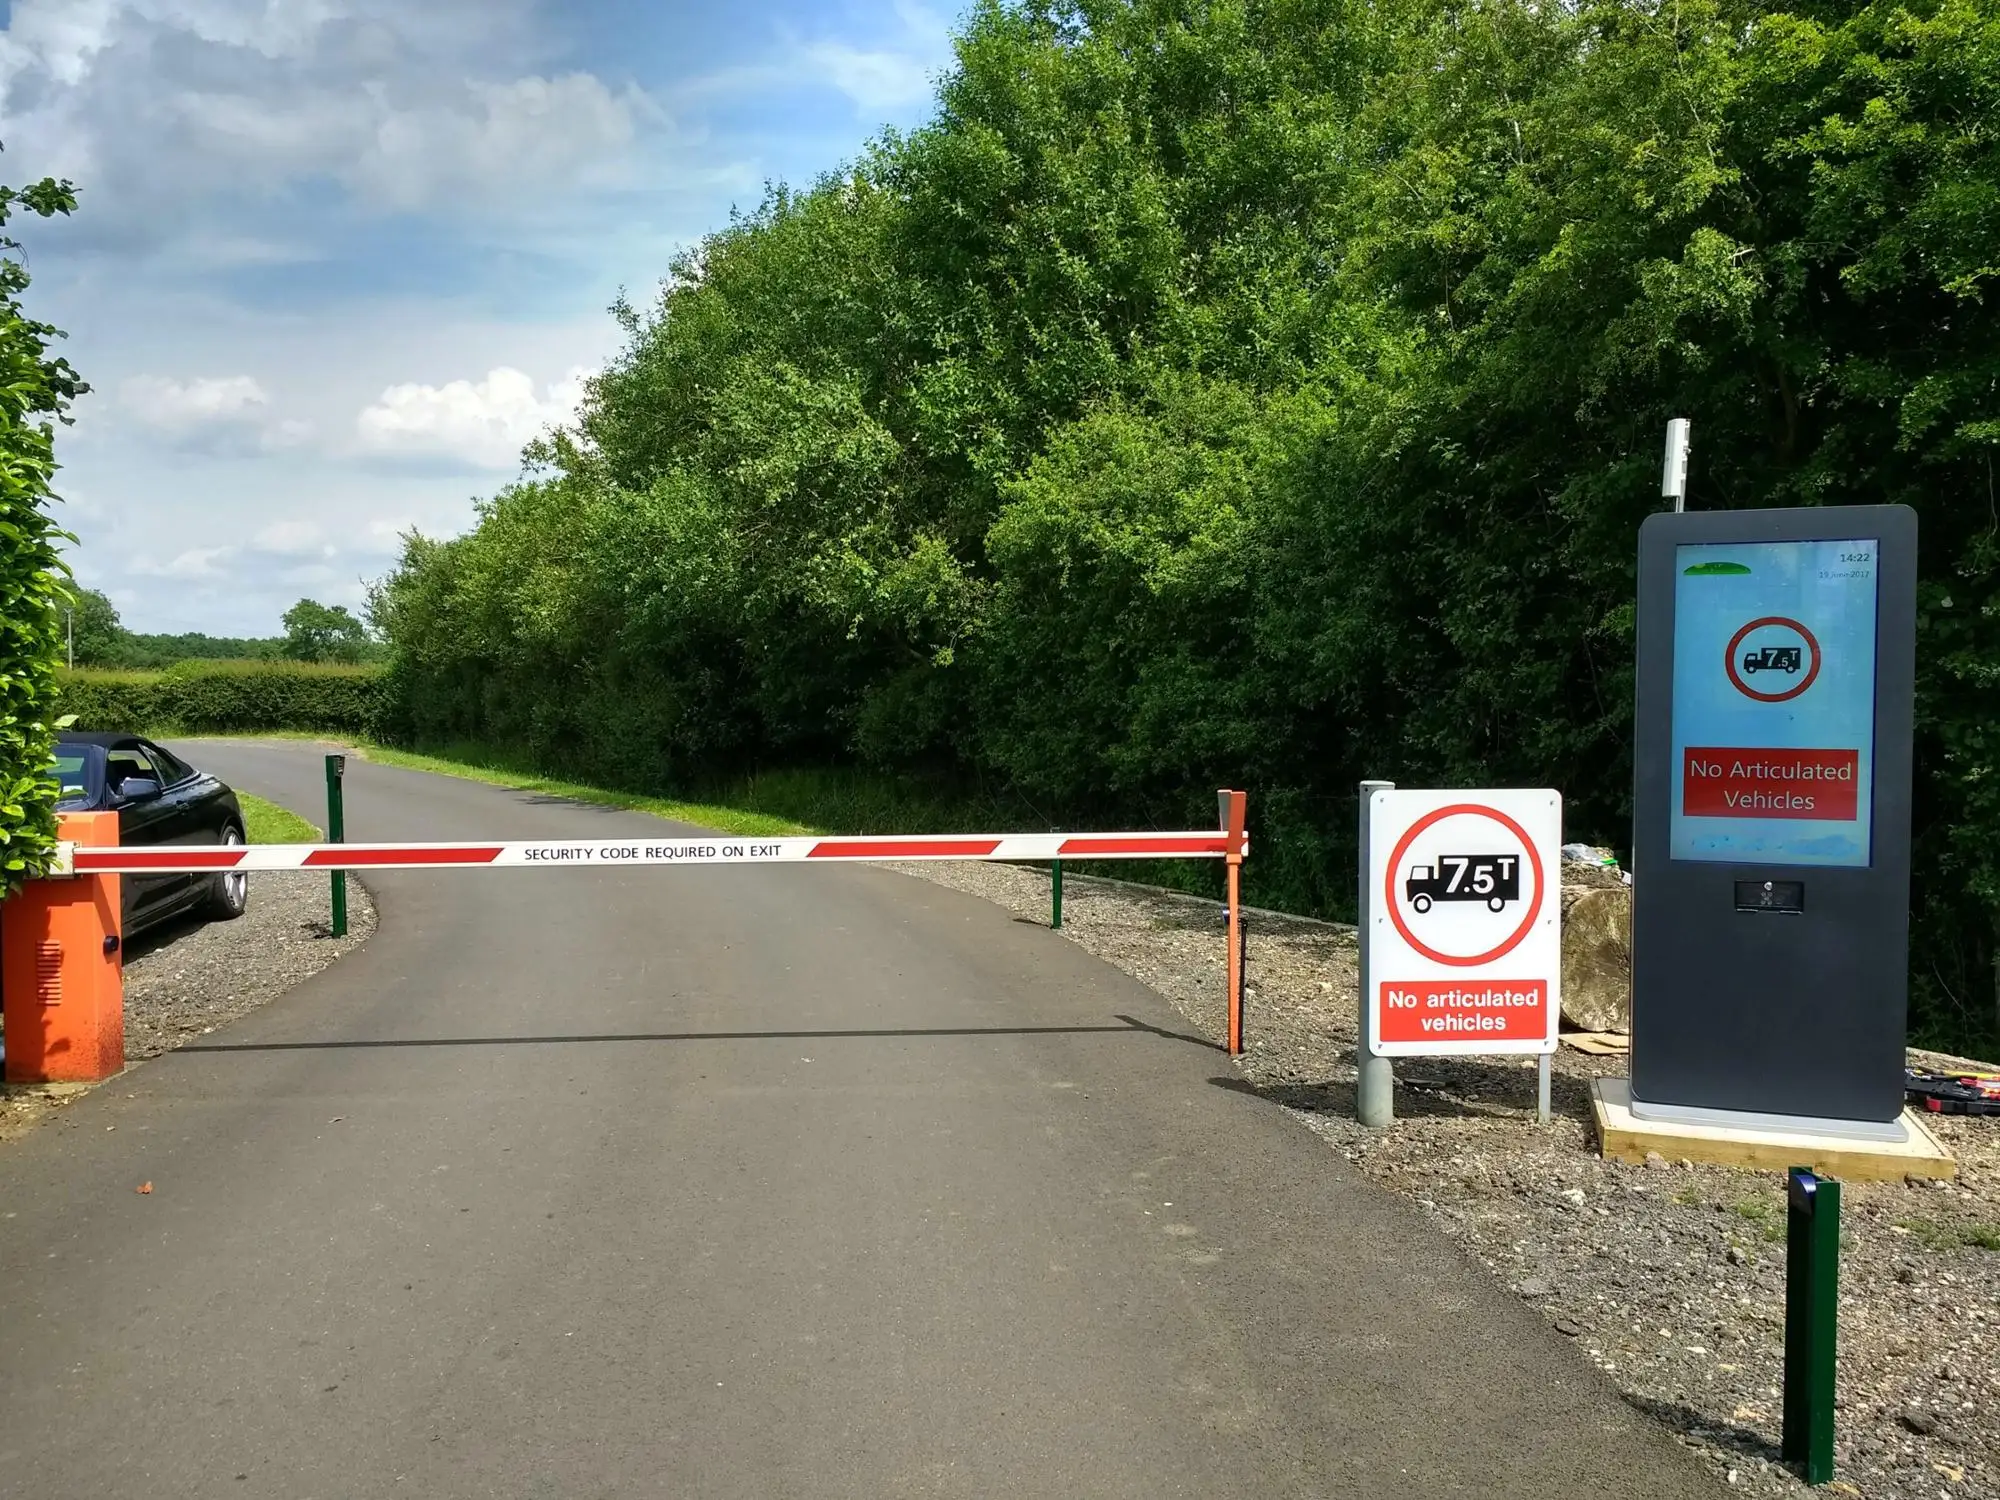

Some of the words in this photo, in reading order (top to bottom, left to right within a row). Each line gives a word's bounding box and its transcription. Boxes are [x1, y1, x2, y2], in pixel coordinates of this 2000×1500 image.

[1840, 553, 1870, 562] 14:22
[1850, 570, 1870, 578] 2017
[1691, 760, 1722, 778] No
[1730, 760, 1851, 780] Articulated
[1724, 790, 1815, 811] Vehicles
[524, 848, 594, 861] SECURITY
[600, 847, 639, 859] CODE
[646, 846, 716, 859] REQUIRED
[722, 846, 744, 857] ON
[750, 845, 782, 857] EXIT
[1443, 858, 1515, 894] 7.5T
[1388, 990, 1417, 1009] No
[1426, 989, 1539, 1008] articulated
[1421, 1013, 1507, 1032] vehicles
